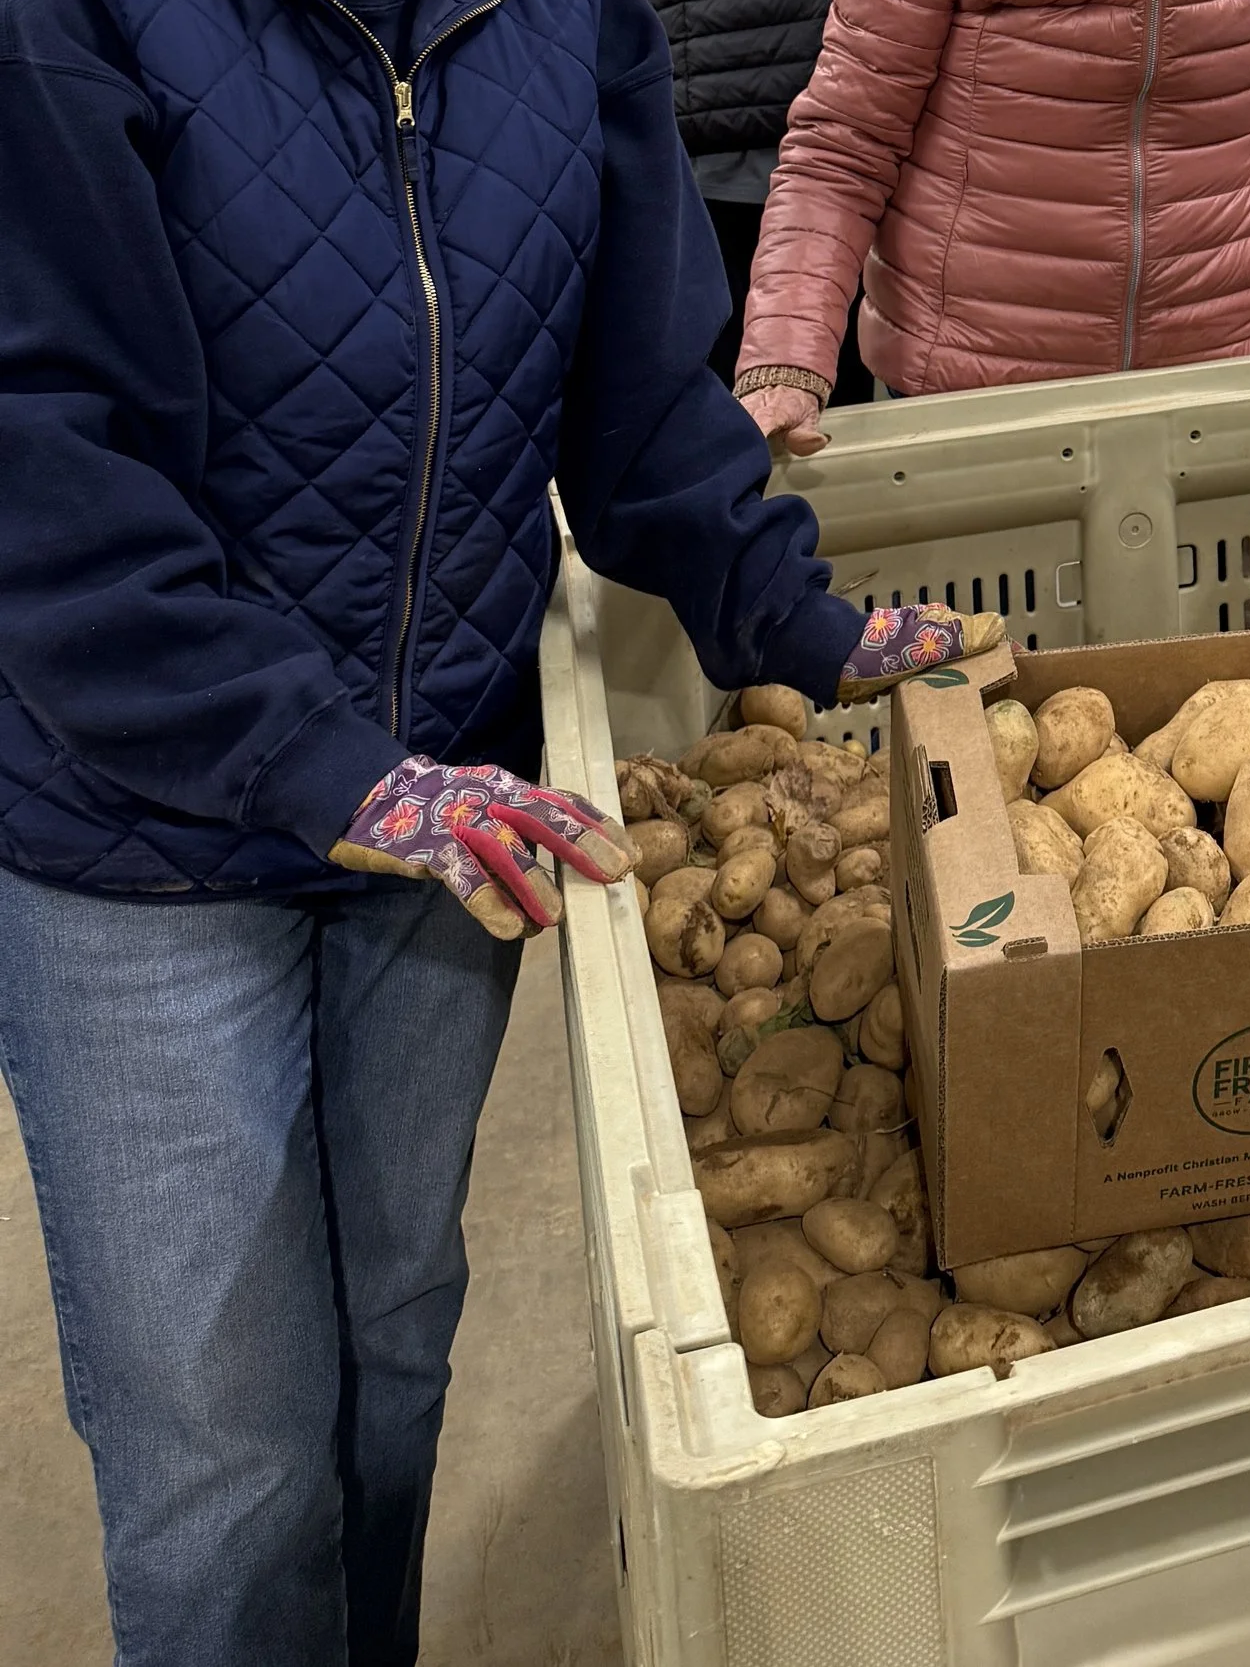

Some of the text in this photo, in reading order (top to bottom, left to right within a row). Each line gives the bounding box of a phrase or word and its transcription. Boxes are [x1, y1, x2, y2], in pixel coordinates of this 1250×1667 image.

[1103, 1174, 1113, 1184] A
[1117, 1163, 1179, 1182] Nonprofit
[1183, 1153, 1239, 1171] Christian
[1192, 1197, 1226, 1211] WASH
